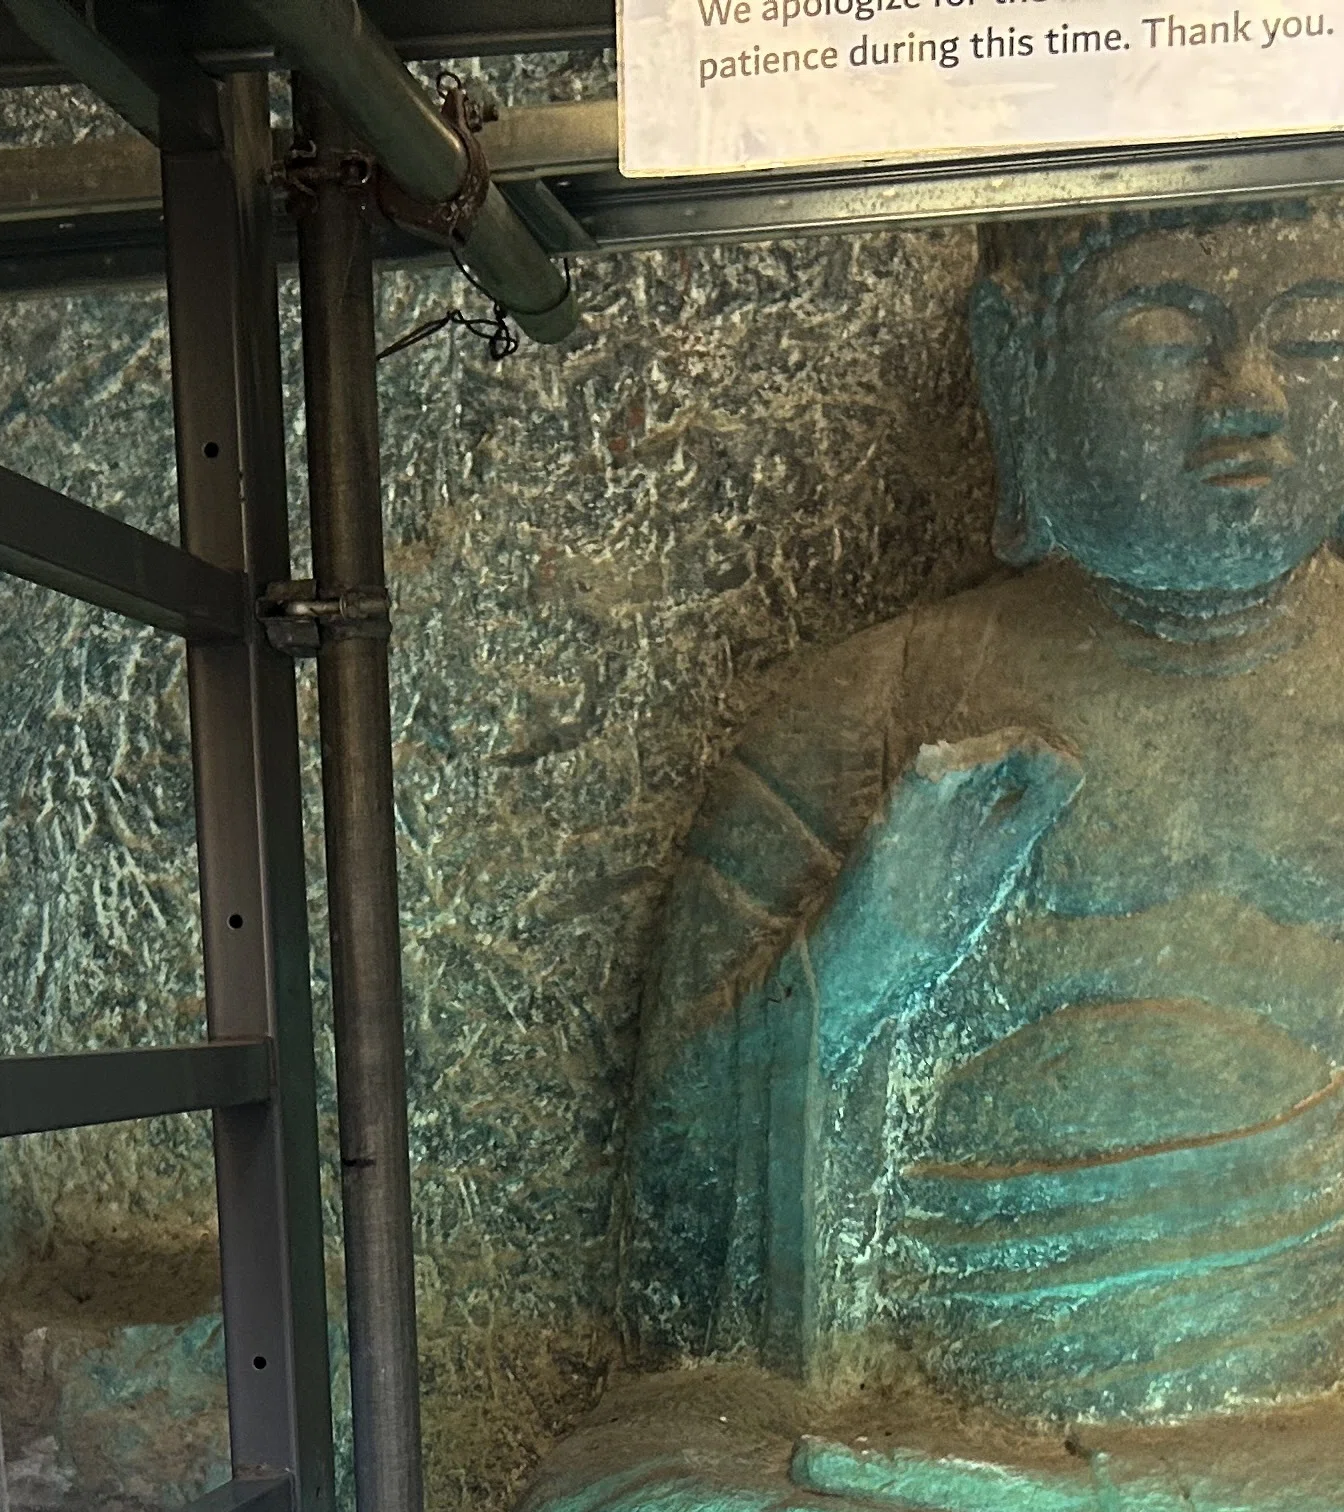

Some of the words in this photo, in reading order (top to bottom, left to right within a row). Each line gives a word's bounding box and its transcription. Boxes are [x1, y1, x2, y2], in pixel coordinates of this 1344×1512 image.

[699, 0, 752, 26] We
[699, 45, 839, 88] patience
[849, 32, 960, 68] during
[969, 26, 1034, 59] this
[1045, 23, 1130, 54] time.
[1141, 10, 1253, 49] Thank
[1260, 13, 1335, 49] you.
